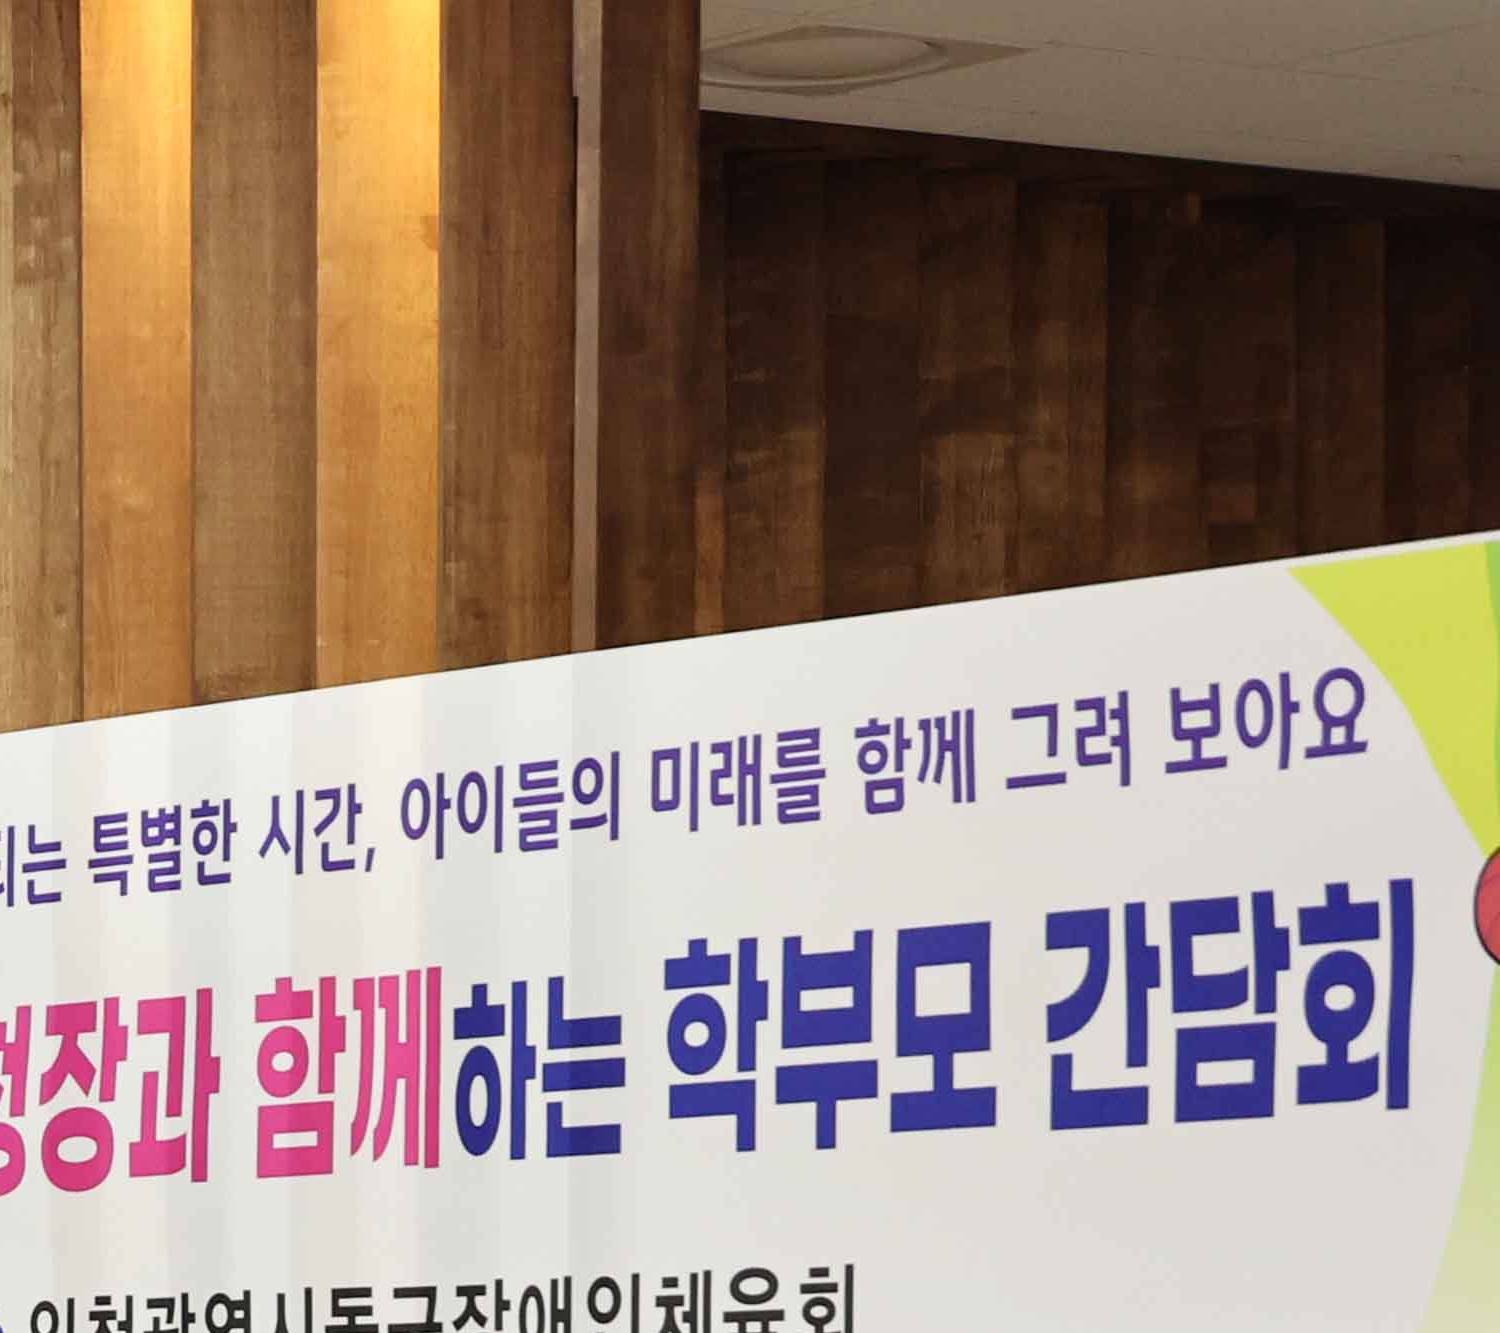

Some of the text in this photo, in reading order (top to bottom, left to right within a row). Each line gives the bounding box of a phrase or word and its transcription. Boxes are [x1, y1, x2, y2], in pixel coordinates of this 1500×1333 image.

[86, 797, 239, 898] 특별한
[258, 782, 376, 877] 시간,
[399, 750, 621, 861] 아이들의
[650, 726, 827, 834] 미래를
[853, 707, 977, 816] 함께
[1010, 689, 1132, 791] 그려
[1164, 666, 1370, 775] 보아요
[254, 965, 627, 1184] 함께하는
[662, 919, 998, 1154] 학부모
[1044, 877, 1416, 1132] 간담회
